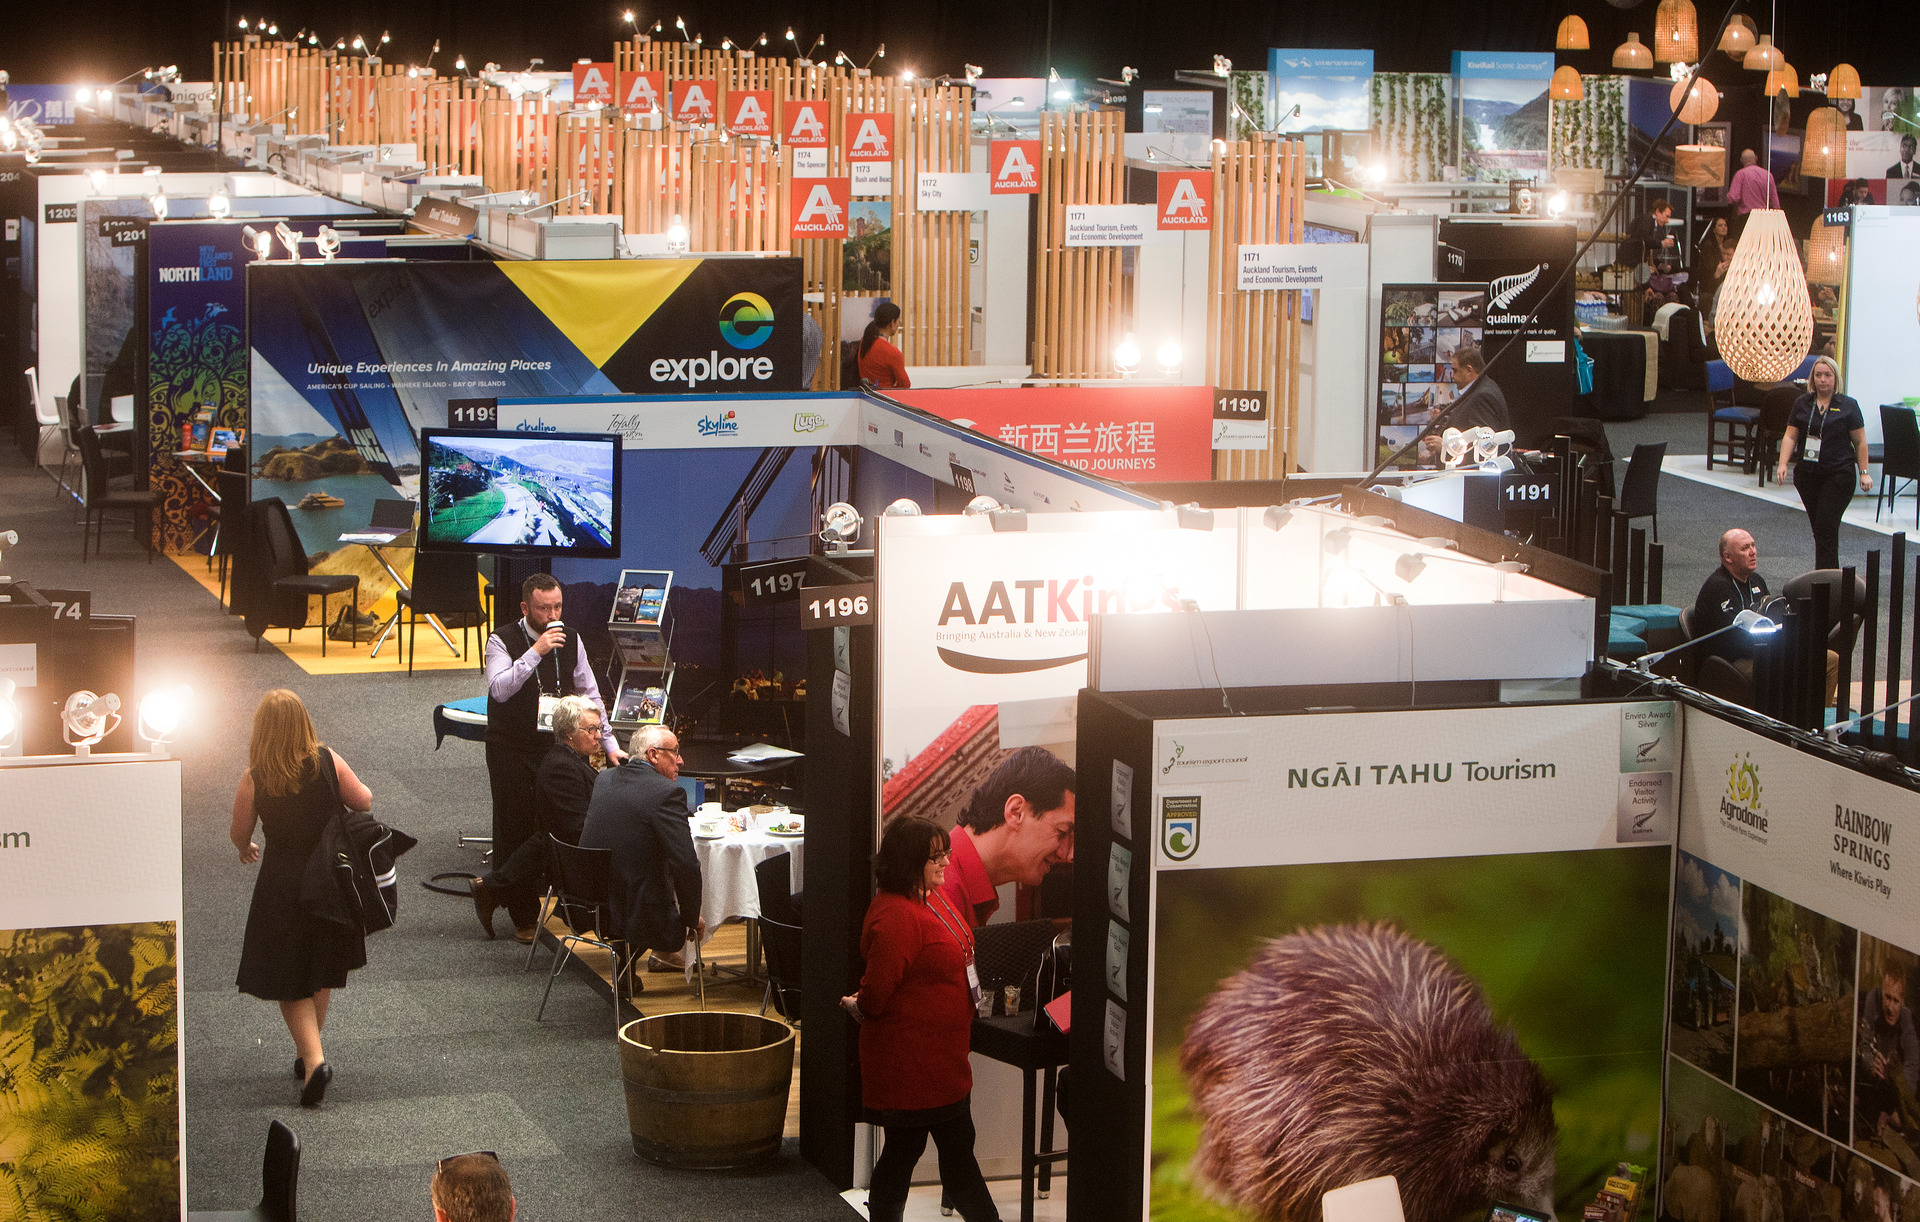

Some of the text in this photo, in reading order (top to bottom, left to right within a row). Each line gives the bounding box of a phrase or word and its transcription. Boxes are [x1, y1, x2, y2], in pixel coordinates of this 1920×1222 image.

[1468, 61, 1495, 69] KiwiRail
[787, 136, 826, 144] AUCKLAND
[797, 151, 811, 159] 1174
[849, 150, 889, 158] AUCKLAND
[807, 161, 826, 169] Spencer
[922, 179, 937, 187] 1172
[921, 190, 942, 198] Sky City
[48, 208, 77, 219] 1203
[1070, 212, 1085, 220] 1171
[1827, 212, 1850, 223] 1163
[1162, 216, 1208, 224] AUCKLAND
[794, 223, 845, 232] AUCKLAND
[1070, 223, 1138, 233] Auckland Tourism, Events
[116, 229, 146, 242] 1201
[1069, 232, 1143, 242] and Economic Development
[1244, 252, 1260, 262] 1171
[1448, 253, 1463, 267] 1170
[159, 267, 233, 283] NORTHLAND
[1243, 265, 1318, 275] Auckland Tourism, Events
[1243, 274, 1323, 285] and Economic Development
[1486, 312, 1539, 326] qualmak
[307, 359, 552, 377] Unique Experiences In Amazing Places
[650, 350, 774, 388] explore
[360, 382, 386, 390] SAILING
[1219, 397, 1261, 412] 1190
[454, 407, 496, 422] 1199
[794, 412, 825, 434] Luge
[998, 420, 1157, 456] 新西兰旅程
[1091, 458, 1157, 471] JOURNEYS
[955, 474, 975, 495] 1198
[1505, 483, 1550, 501] 1191
[750, 571, 807, 596] 1197
[937, 575, 1182, 626] AATKins
[51, 602, 82, 620] 74
[808, 596, 869, 619] 1196
[936, 630, 977, 644] Bringing
[979, 629, 1021, 640] Australia
[1024, 629, 1032, 638] &
[1035, 629, 1056, 638] New
[1648, 710, 1671, 719] Award
[1225, 756, 1248, 764] council
[1287, 758, 1556, 789] NGĀI TAHU Tourism
[1629, 779, 1662, 787] Endorsed
[1634, 788, 1656, 796] Visitor
[1632, 797, 1657, 806] Activity
[1719, 795, 1768, 834] Agrodome
[1834, 803, 1892, 847] RAINBOW
[1833, 833, 1890, 871] SPRINGS
[1829, 860, 1892, 900] Where Kiwis Play
